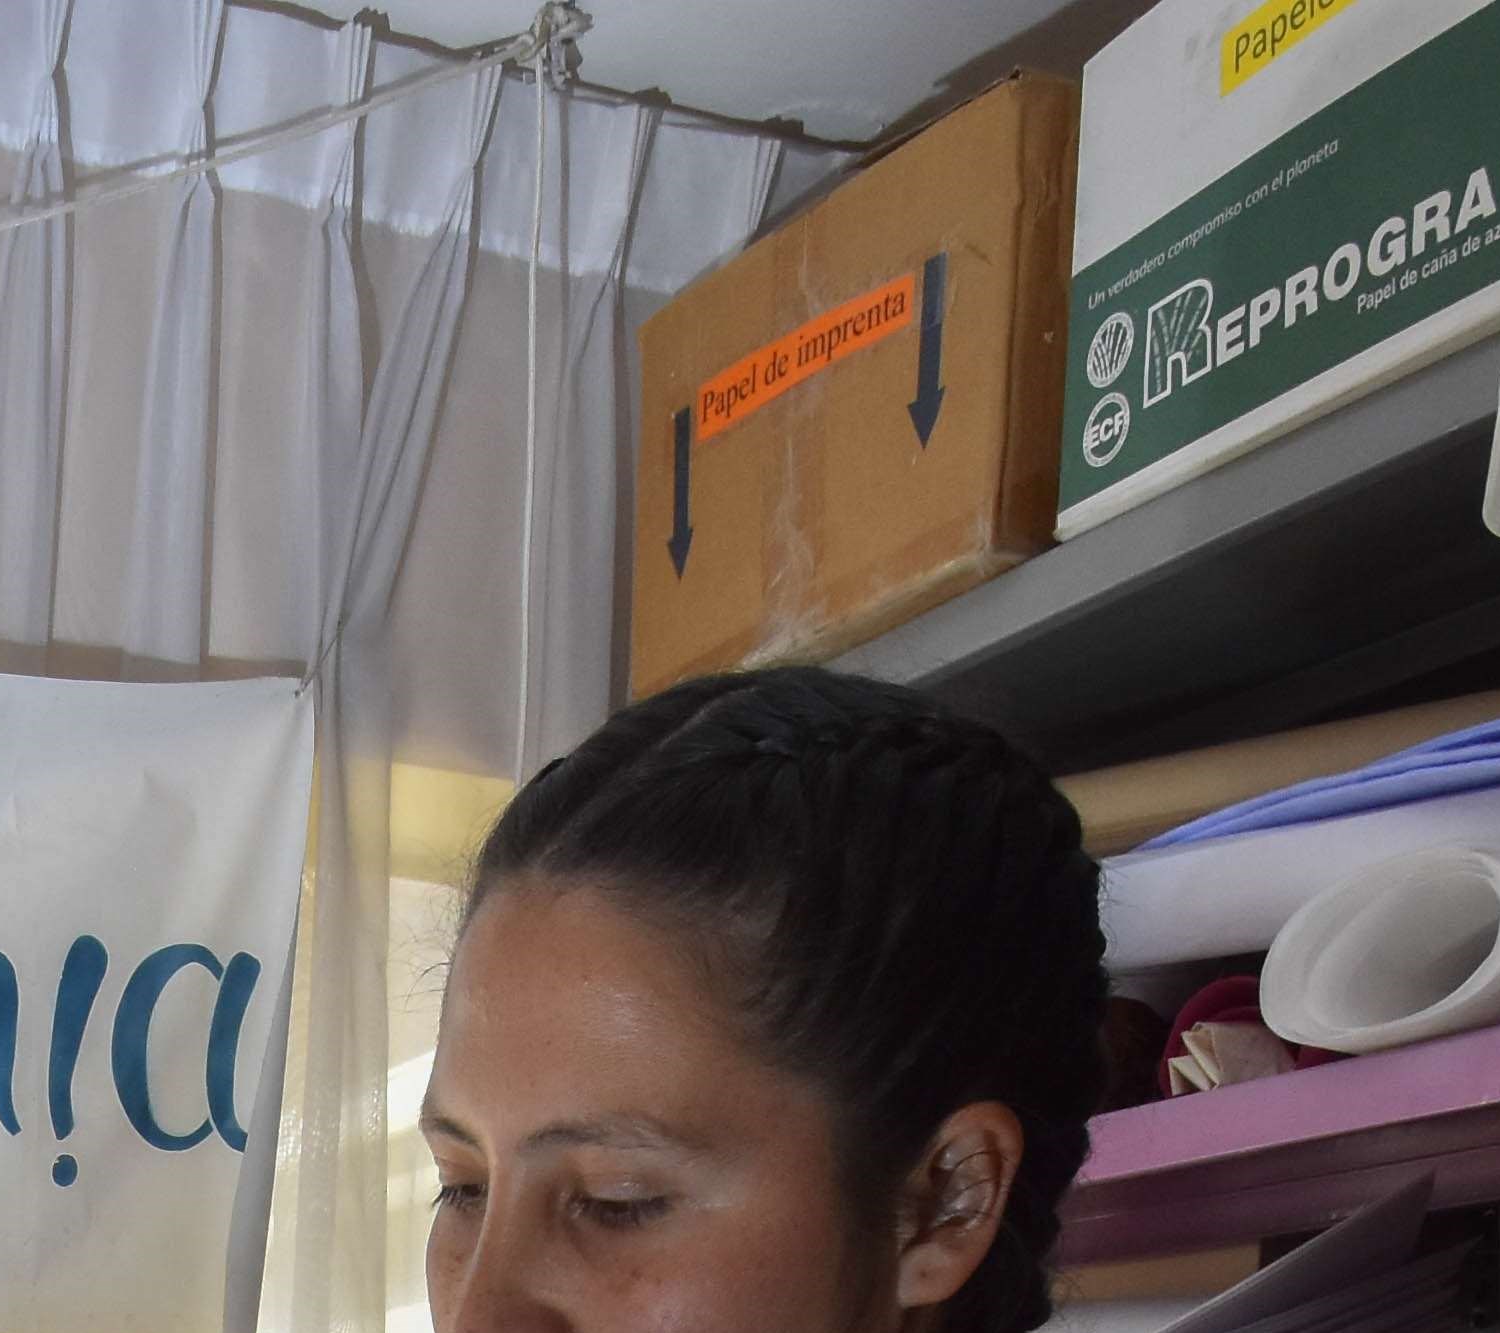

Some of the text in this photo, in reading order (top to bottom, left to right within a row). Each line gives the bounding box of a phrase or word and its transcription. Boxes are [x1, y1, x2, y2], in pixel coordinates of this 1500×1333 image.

[1087, 138, 1339, 310] Un verdadero compromiso con el planeta
[1356, 276, 1397, 315] Papel
[1399, 268, 1418, 290] de
[1421, 249, 1458, 280] caña
[1461, 234, 1481, 258] de
[702, 290, 906, 425] Papel de imprenta
[1085, 410, 1125, 450] ECF
